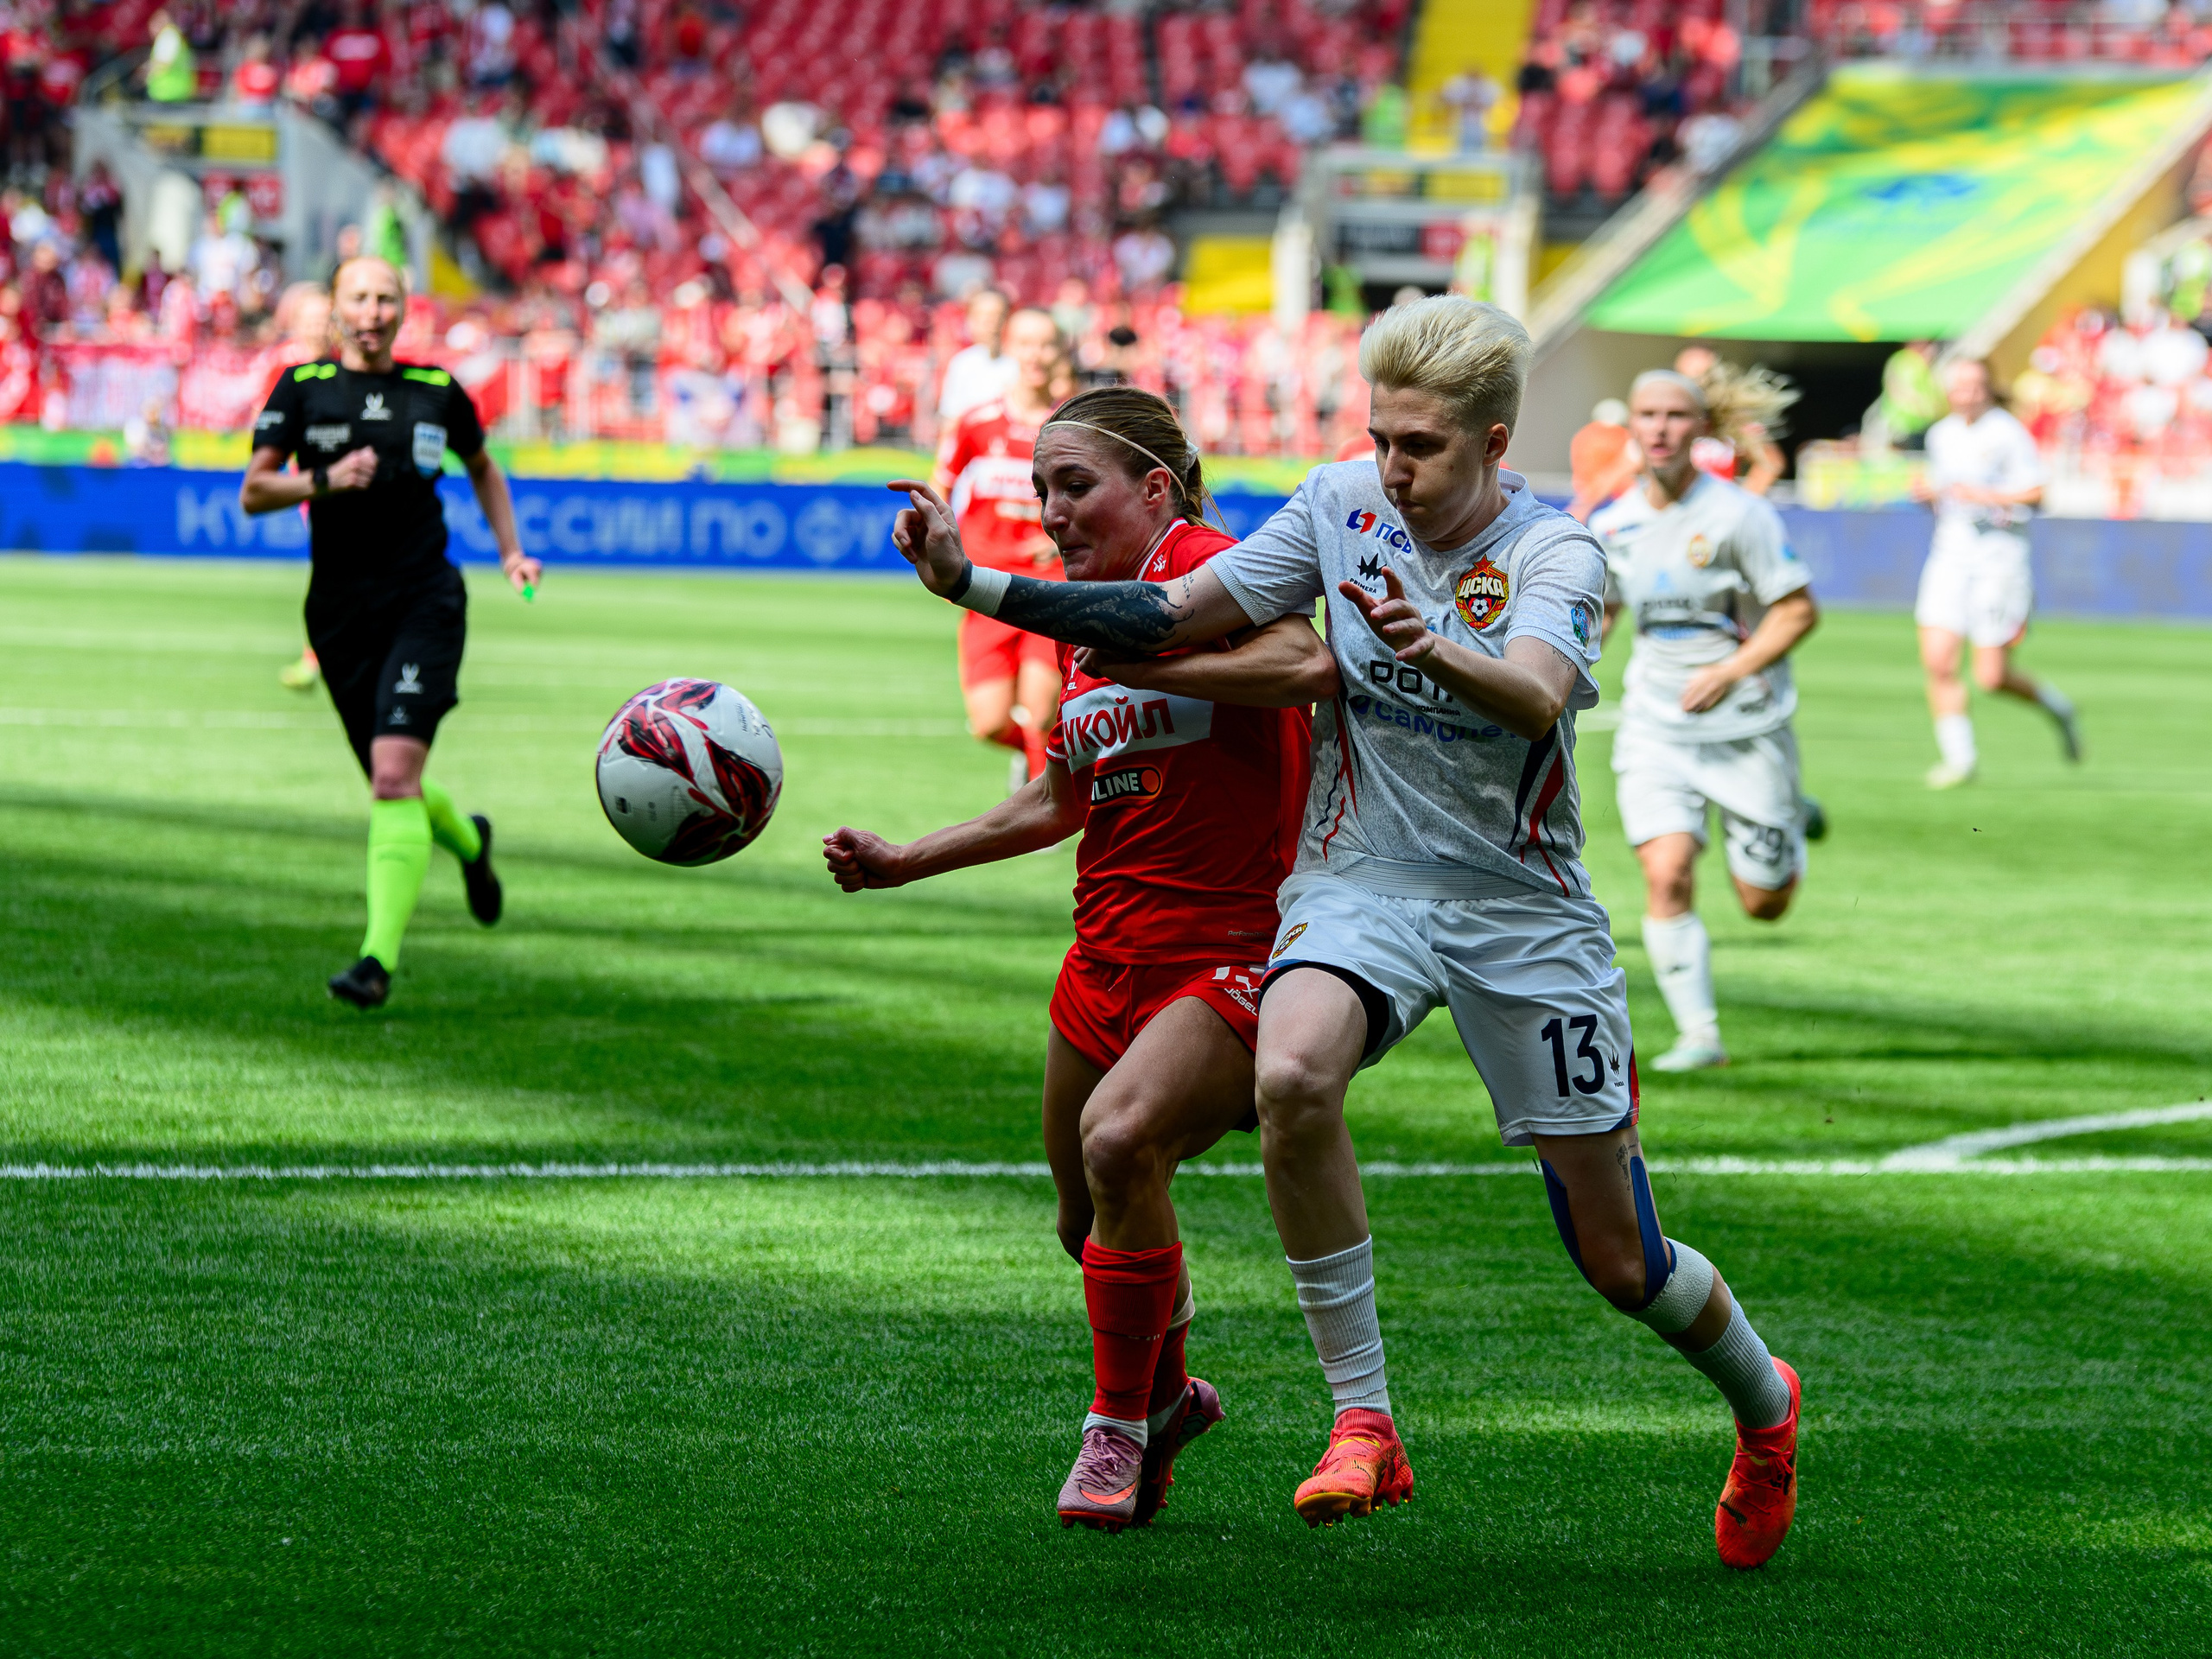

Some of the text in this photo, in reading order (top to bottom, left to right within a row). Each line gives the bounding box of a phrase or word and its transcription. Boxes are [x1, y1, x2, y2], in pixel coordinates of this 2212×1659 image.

[1349, 578, 1377, 594] PRIMERA
[1458, 576, 1505, 599] ЦСКА
[1064, 696, 1175, 760] УКОЙЛ
[1375, 701, 1517, 743] самоле
[1224, 987, 1258, 1017] JÖGEL
[1541, 1014, 1605, 1097] 13
